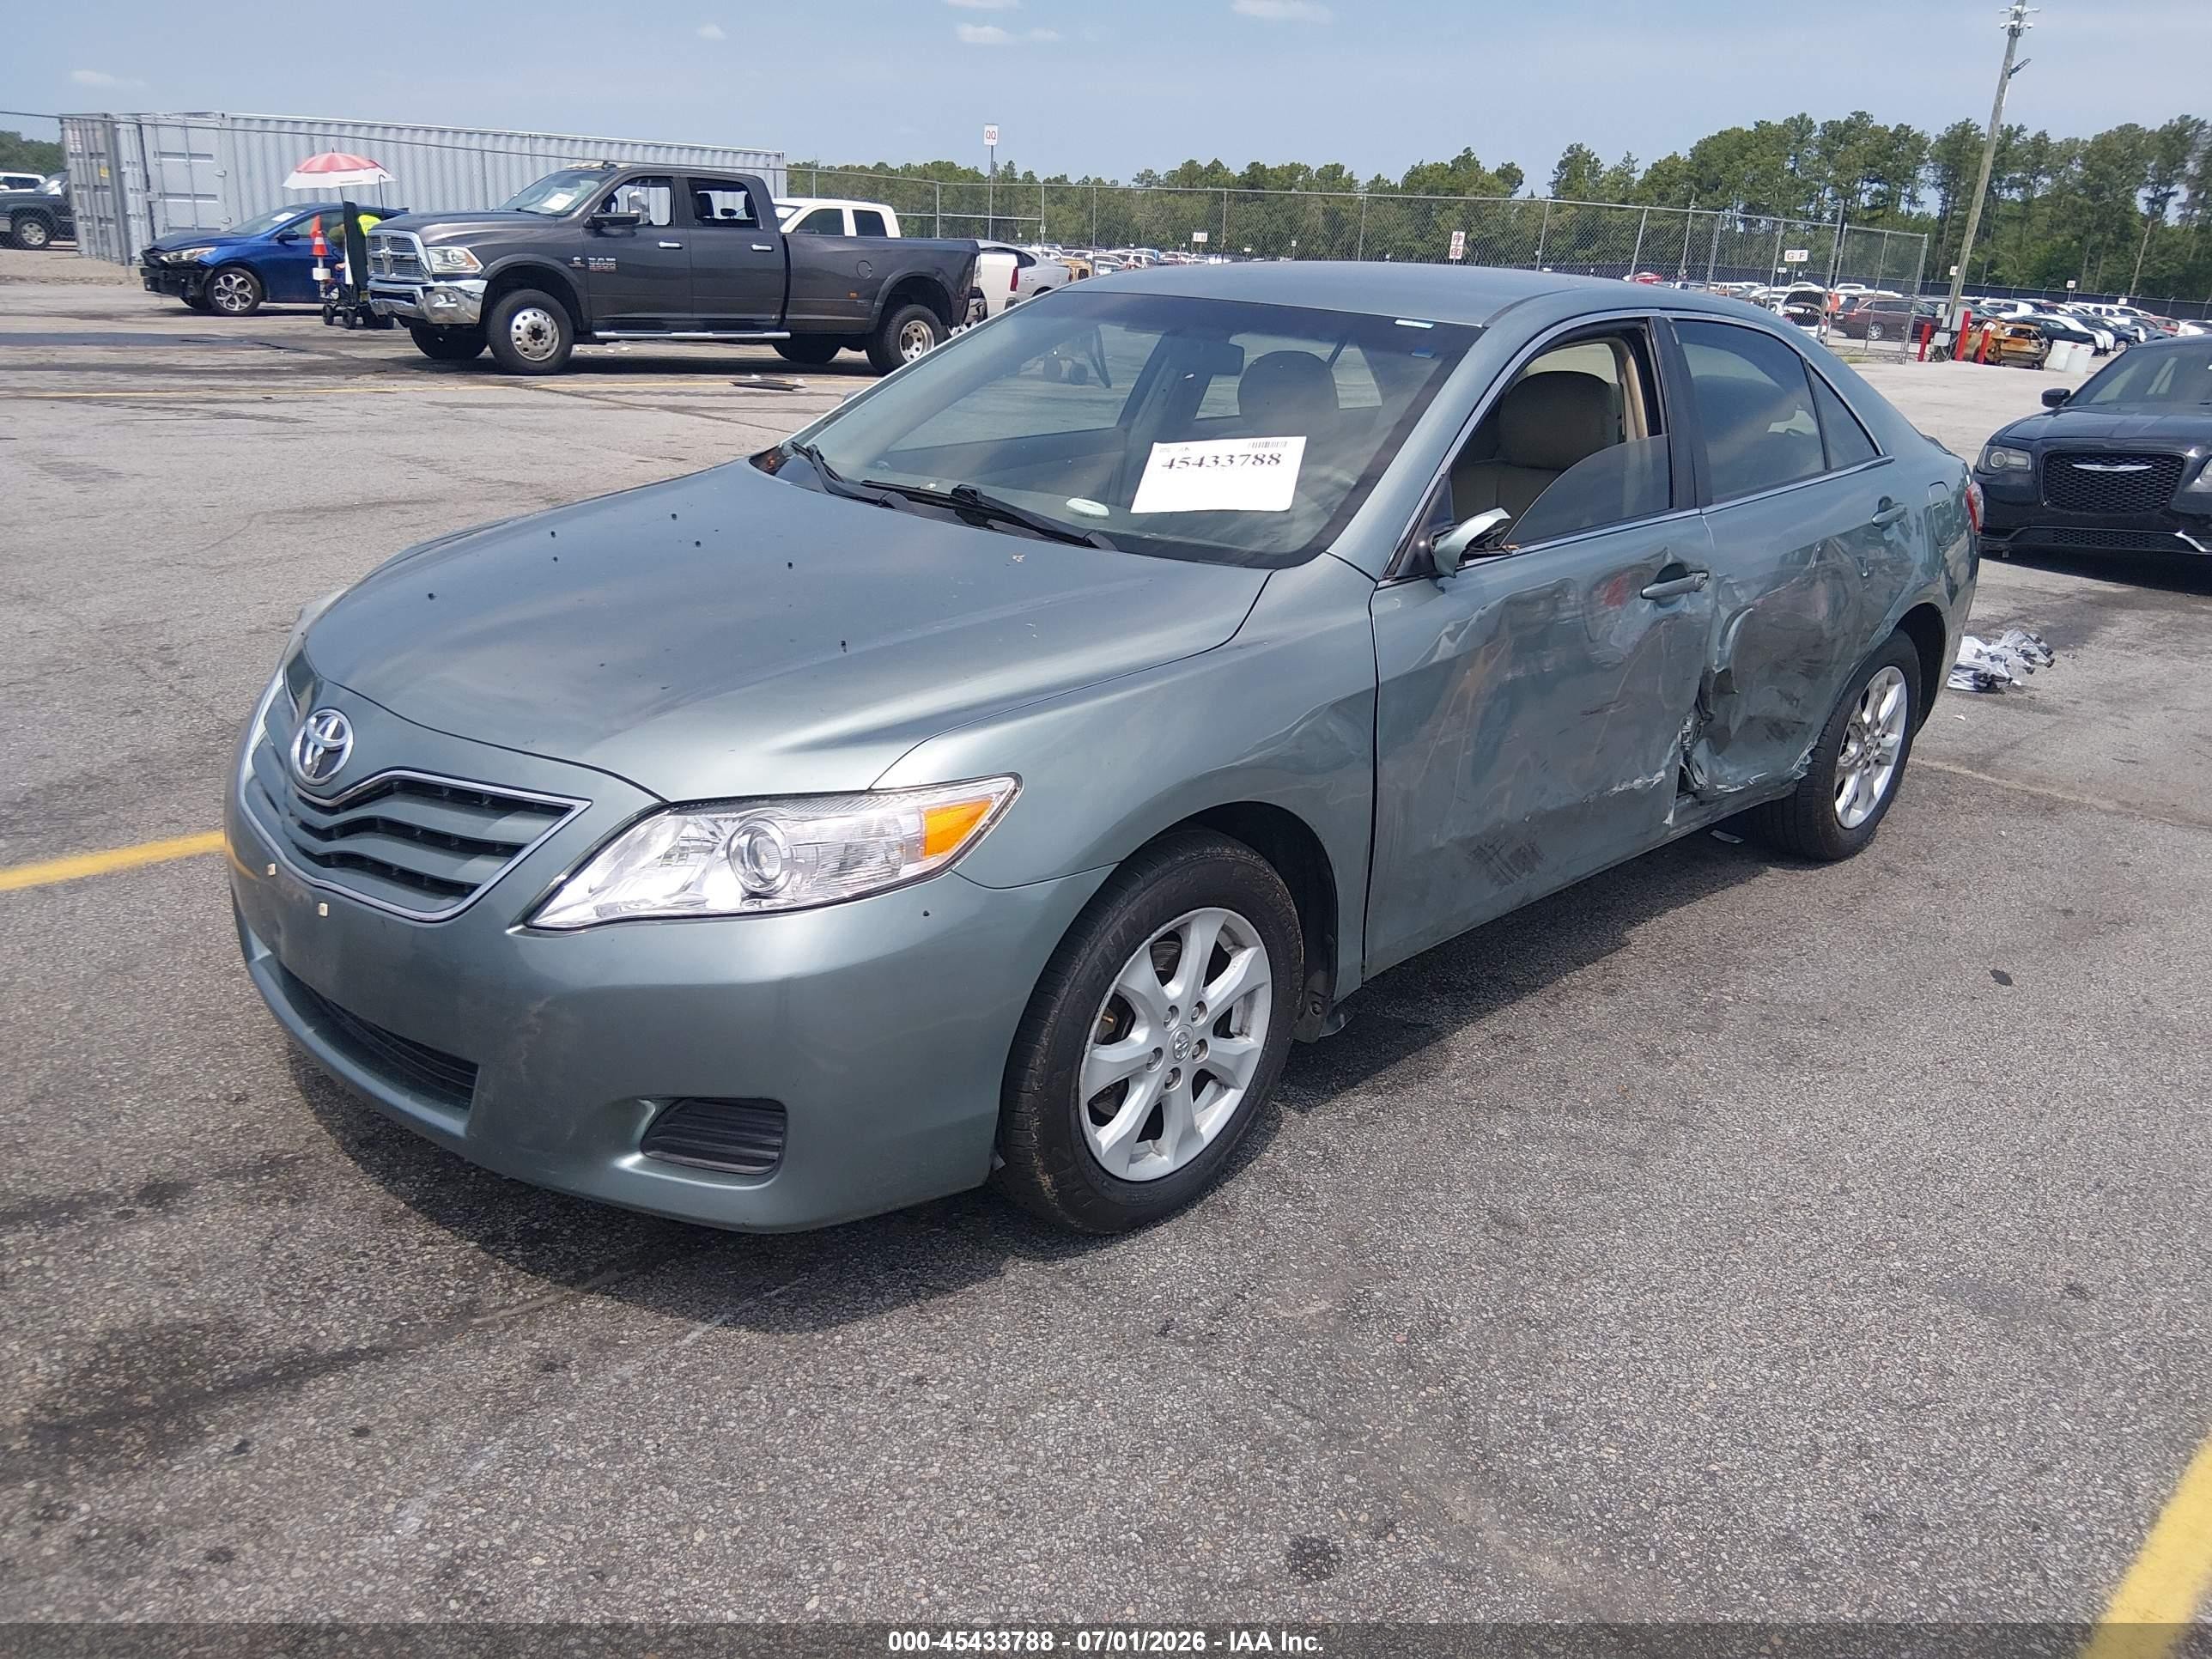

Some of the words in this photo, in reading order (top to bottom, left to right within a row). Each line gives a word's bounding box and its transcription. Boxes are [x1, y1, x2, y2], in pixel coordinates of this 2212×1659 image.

[1787, 252, 1795, 260] G
[1799, 252, 1807, 260] F
[1161, 453, 1282, 470] 45433788
